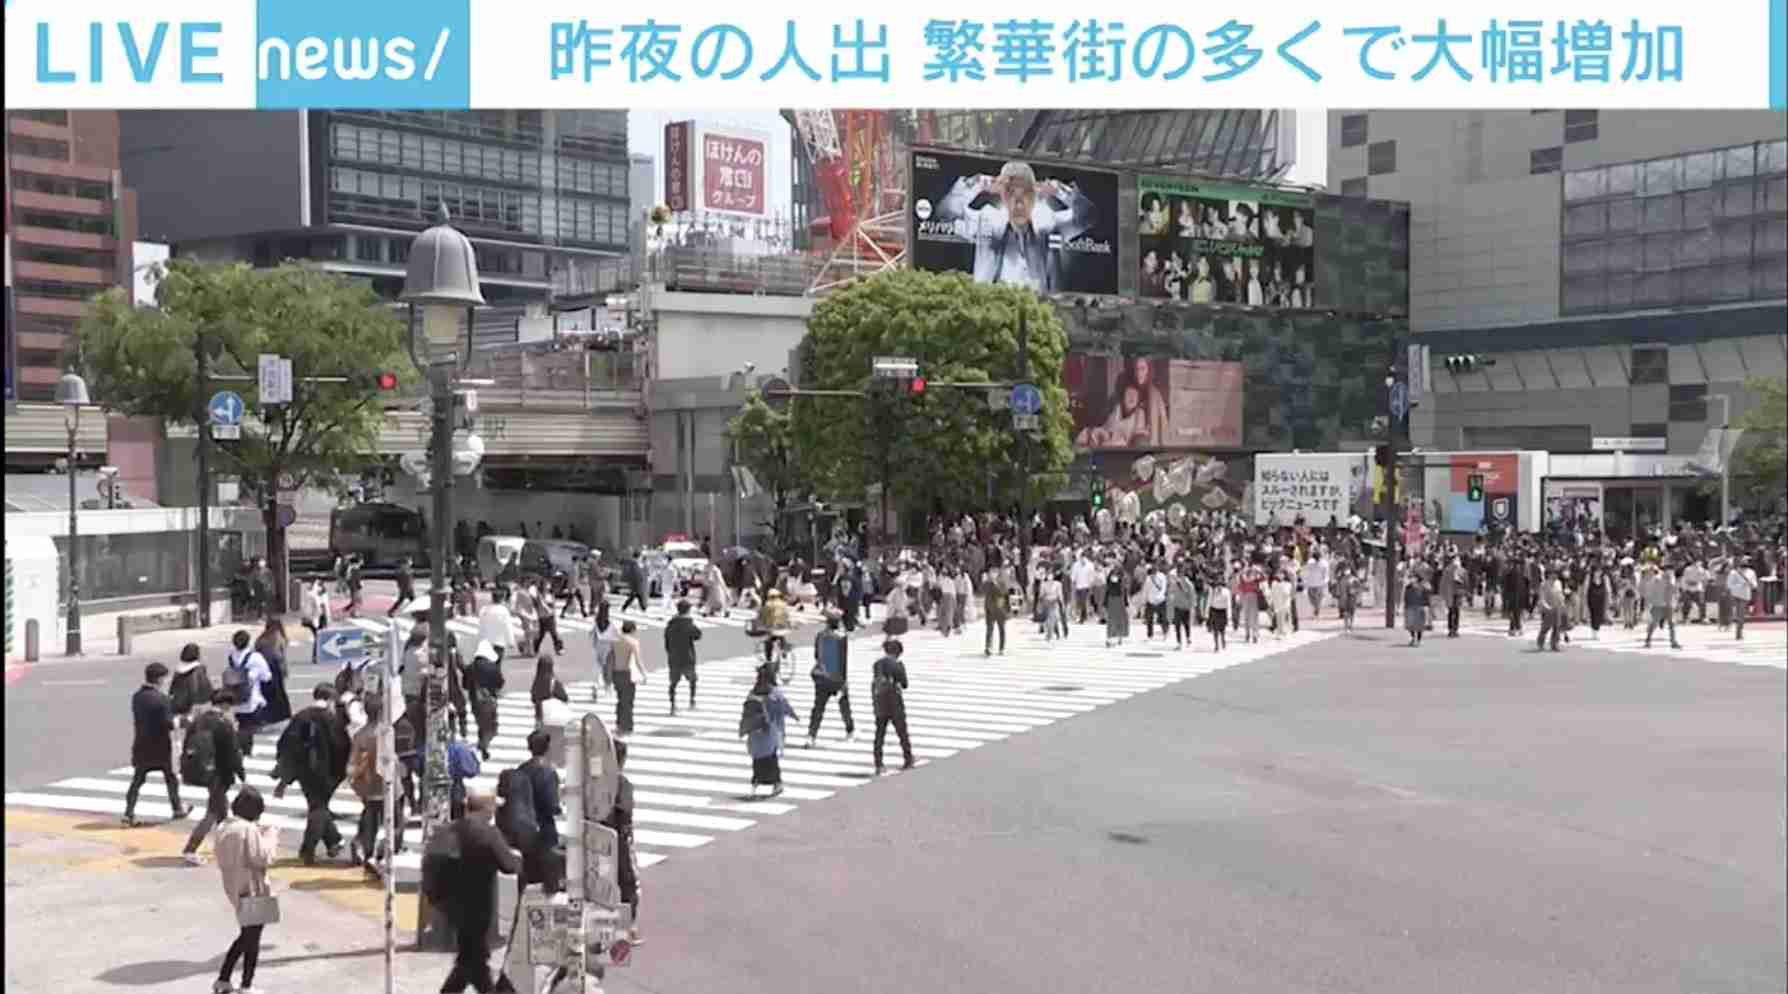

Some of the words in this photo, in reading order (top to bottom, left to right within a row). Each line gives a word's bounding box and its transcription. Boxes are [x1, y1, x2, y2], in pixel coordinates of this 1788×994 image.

[706, 139, 762, 166] ほけんの
[1064, 237, 1111, 253] SoftBank
